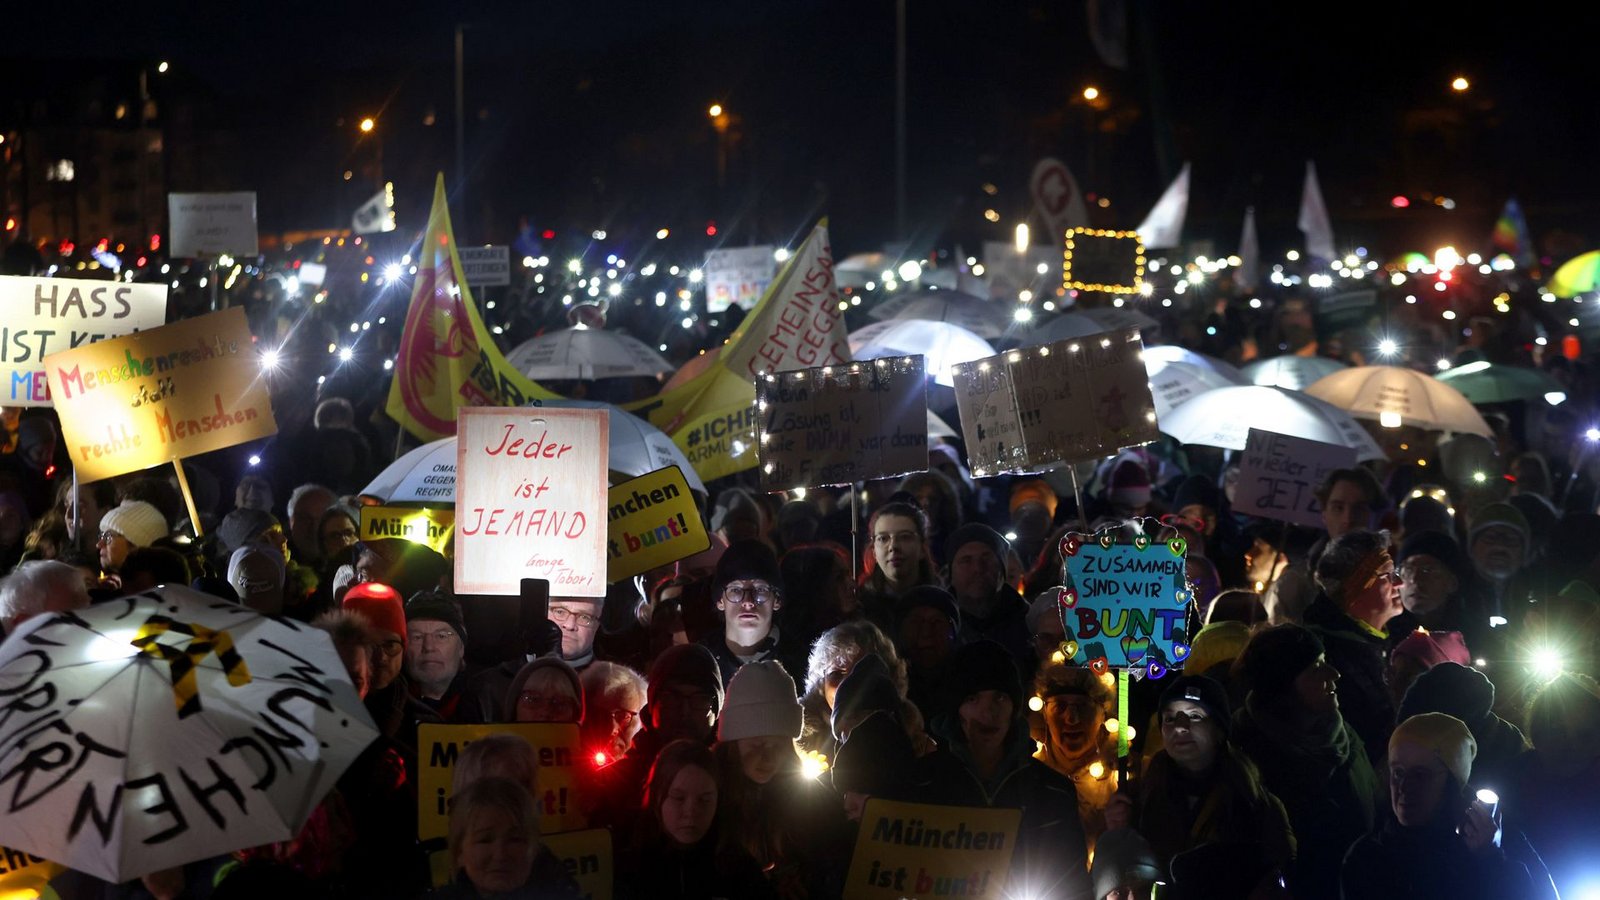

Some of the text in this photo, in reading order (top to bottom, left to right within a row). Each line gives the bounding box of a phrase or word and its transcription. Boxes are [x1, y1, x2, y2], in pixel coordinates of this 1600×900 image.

[34, 284, 132, 319] HASS
[1, 327, 56, 363] IST
[796, 292, 842, 366] GEGE
[58, 335, 237, 400] Menschenrechte
[131, 376, 176, 408] statt
[155, 394, 258, 444] Menschen
[767, 408, 832, 433] Lösung
[80, 425, 142, 462] rechte
[485, 424, 572, 459] Jeder
[891, 426, 927, 447] dann
[1249, 431, 1287, 457] NIE
[1248, 456, 1307, 476] wieder
[415, 487, 453, 497] RECHTS
[514, 476, 549, 499] ist
[462, 508, 587, 539] JEMAND
[623, 512, 689, 553] bunt!
[525, 552, 565, 576] George
[1082, 555, 1184, 575] ZUSAMMEN
[1082, 577, 1163, 598] SIND WIR
[1075, 607, 1186, 640] BUNT
[66, 637, 348, 845] MÜNCHEN
[870, 816, 1007, 850] München
[867, 860, 992, 896] ist bunt!
